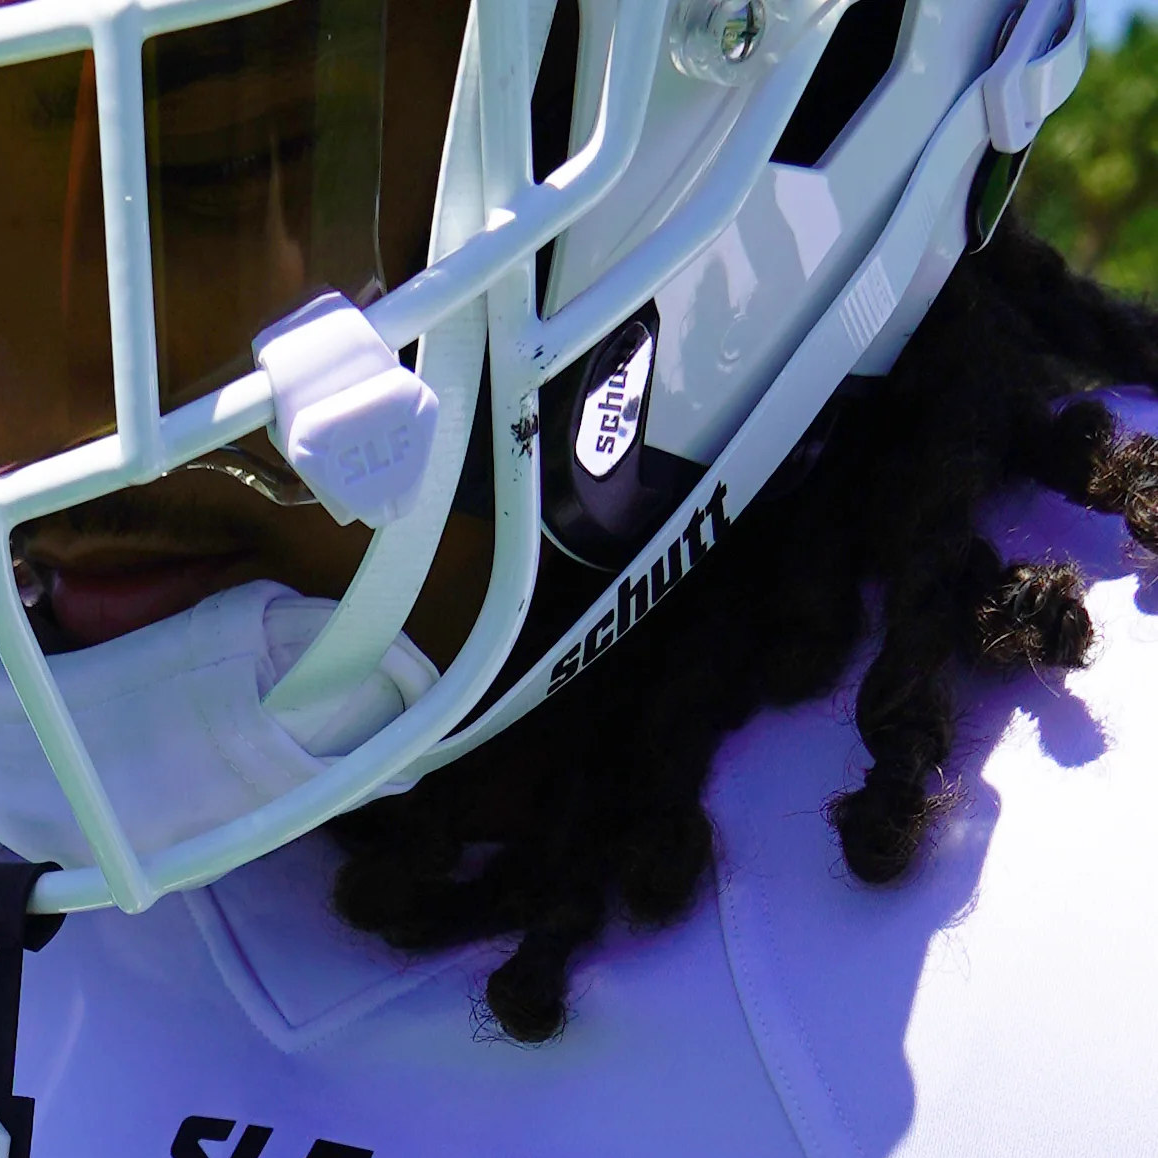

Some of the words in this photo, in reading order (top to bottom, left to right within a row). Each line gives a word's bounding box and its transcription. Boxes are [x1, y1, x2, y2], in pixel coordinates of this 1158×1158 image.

[595, 365, 629, 454] schu
[337, 424, 410, 485] SLF
[545, 480, 732, 697] schutt
